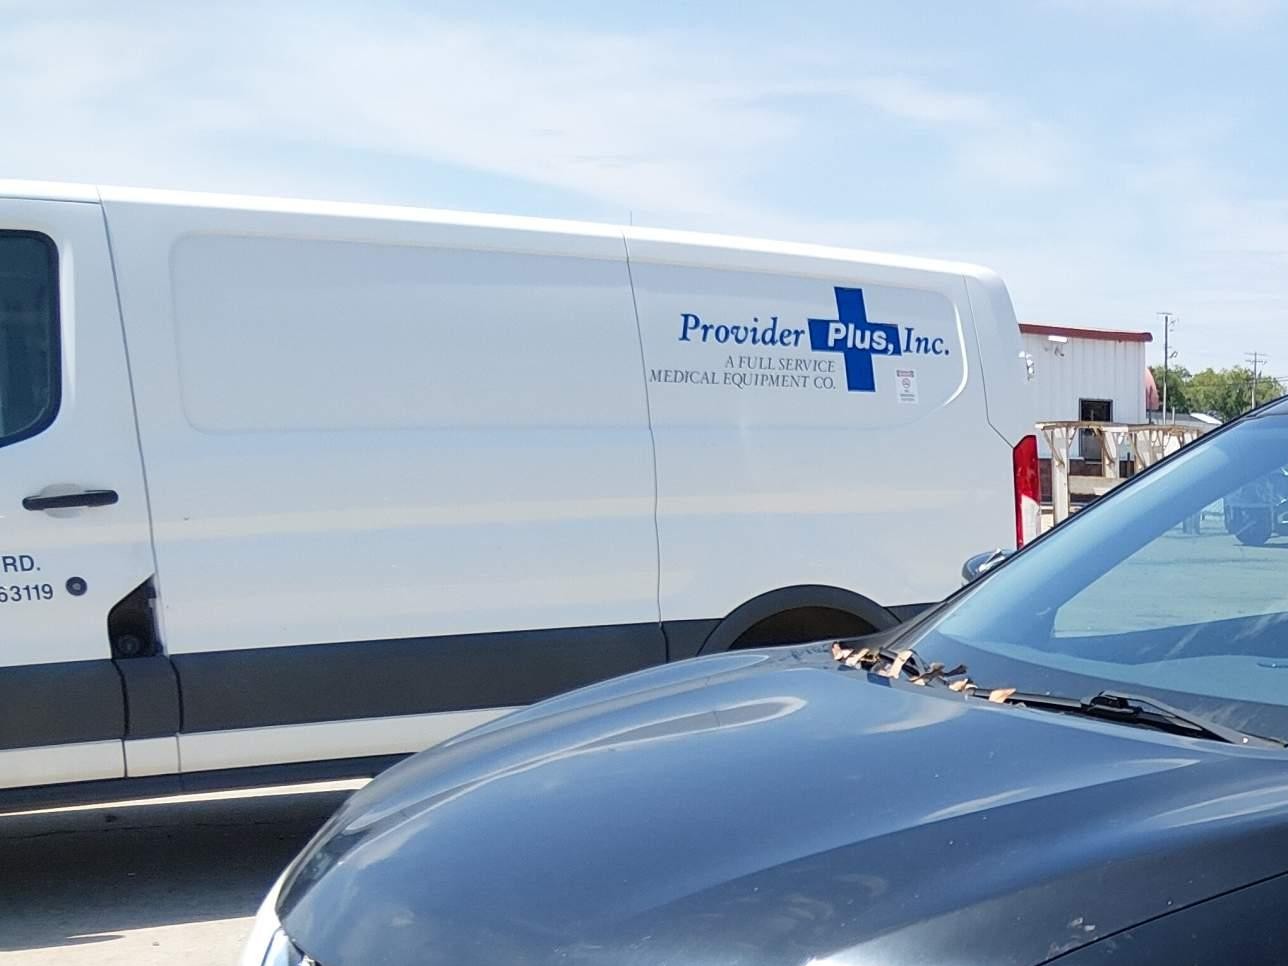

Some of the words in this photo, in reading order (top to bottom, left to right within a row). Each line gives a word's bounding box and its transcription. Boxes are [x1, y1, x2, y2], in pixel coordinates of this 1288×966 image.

[678, 313, 805, 347] Provider
[827, 321, 894, 356] Plus,
[904, 327, 950, 356] Inc.
[725, 355, 735, 369] A
[738, 356, 774, 371] FULL
[778, 357, 836, 373] SERVICE
[650, 369, 720, 386] MEDICAL
[723, 371, 809, 389] EQUIPMENT
[814, 376, 836, 390] CO.
[2, 555, 41, 573] RD.
